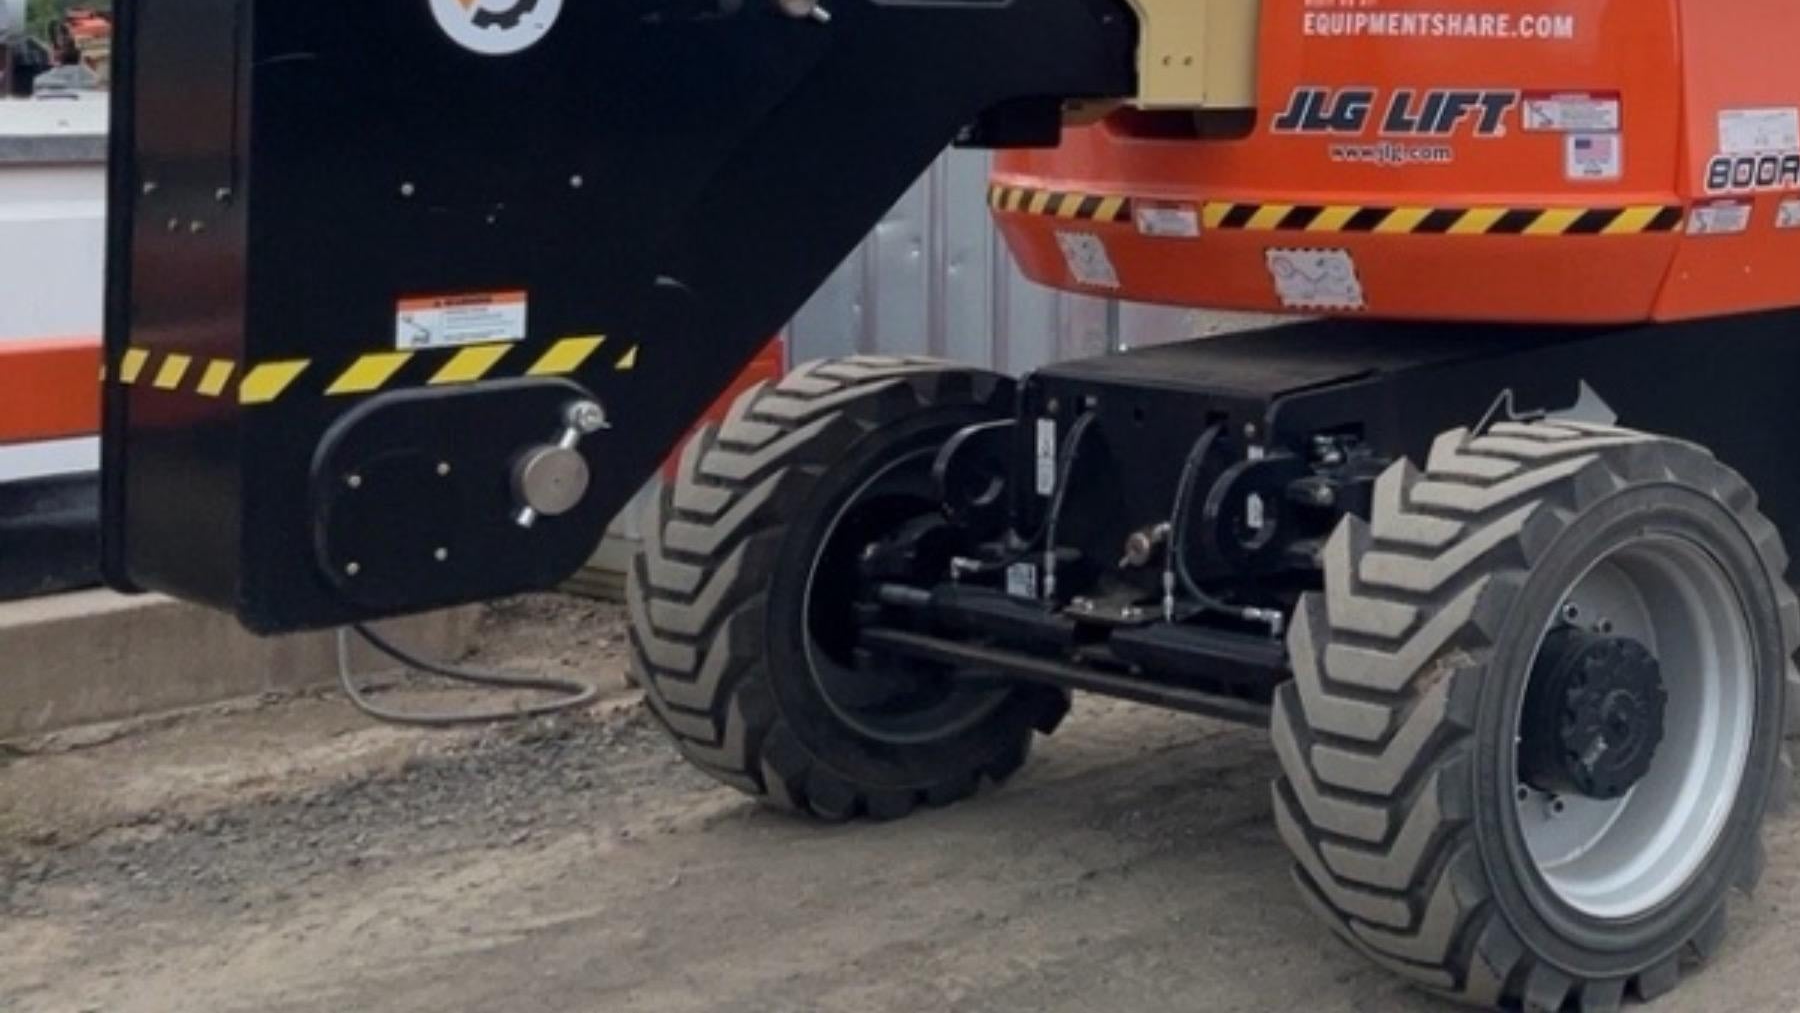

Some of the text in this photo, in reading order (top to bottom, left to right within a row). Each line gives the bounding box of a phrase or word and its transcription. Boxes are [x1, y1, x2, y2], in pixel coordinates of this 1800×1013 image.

[1303, 11, 1574, 39] EQUIPMENTSHARE.COM
[1271, 86, 1377, 135] JLG
[1378, 88, 1521, 137] LIFT
[1330, 142, 1453, 166] www.jlg.com
